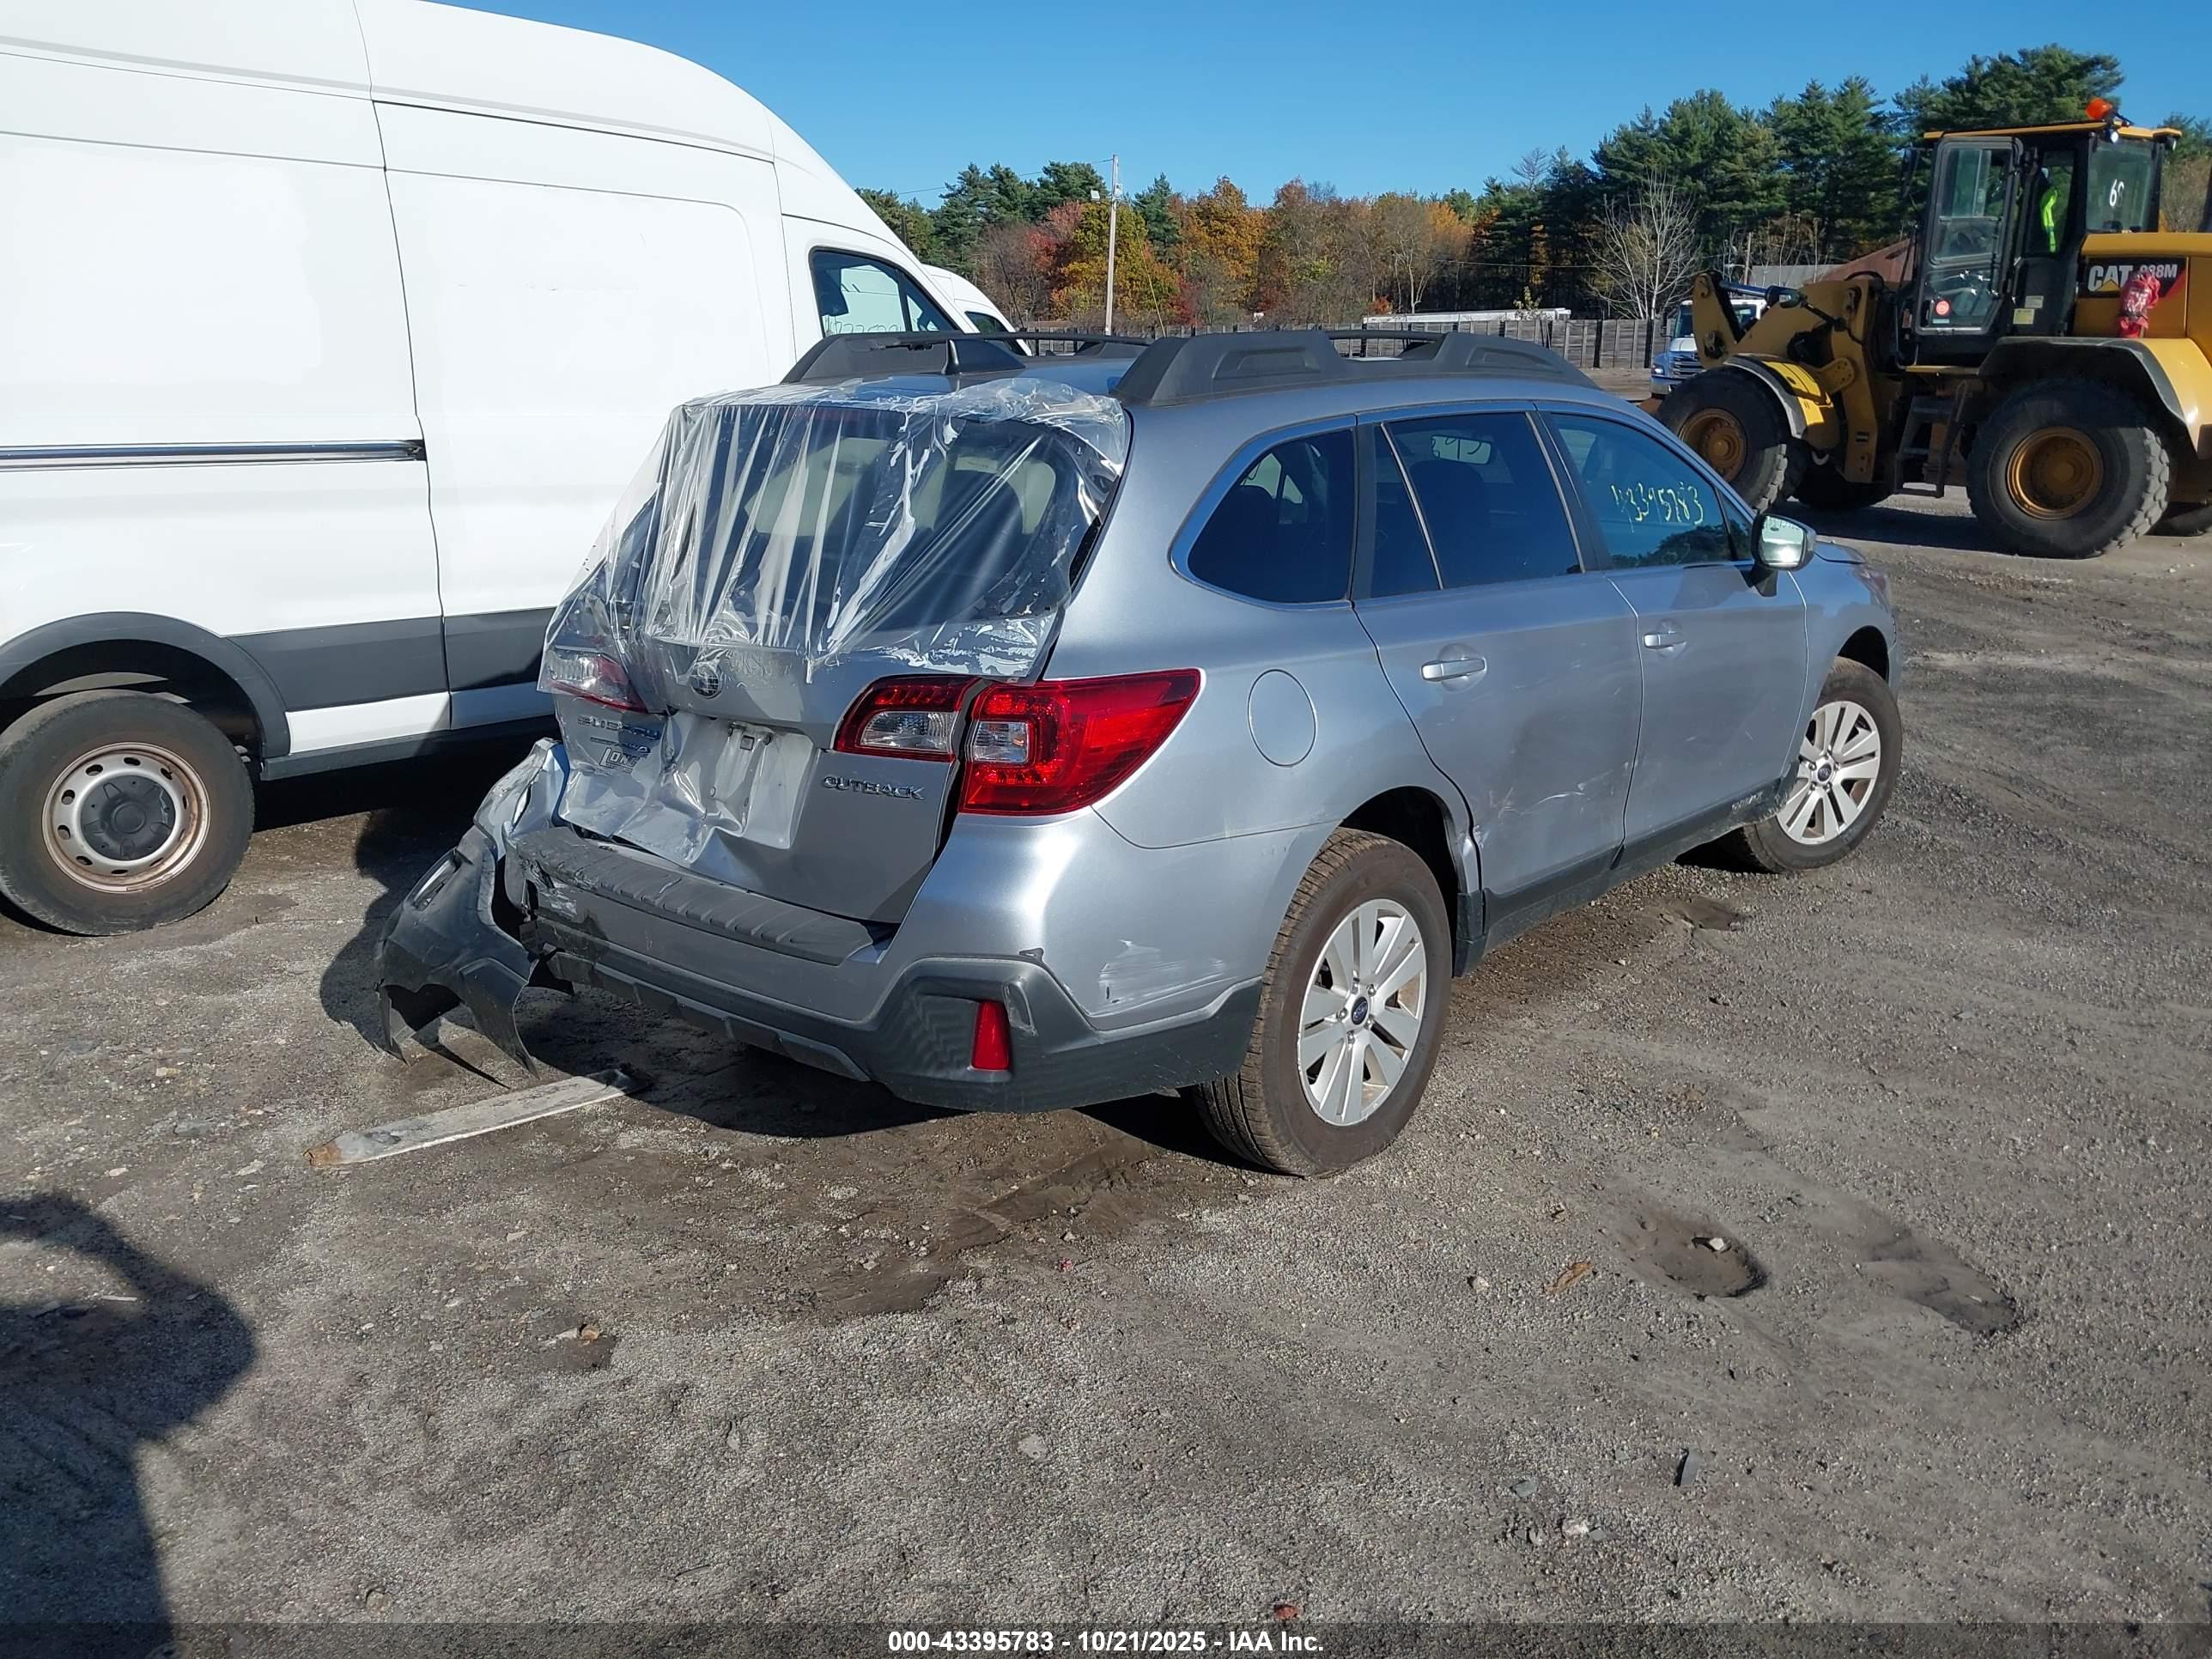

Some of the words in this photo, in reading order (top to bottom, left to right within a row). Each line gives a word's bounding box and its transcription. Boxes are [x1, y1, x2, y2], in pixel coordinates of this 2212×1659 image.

[2087, 264, 2134, 292] CAT
[1610, 481, 1704, 534] 43395783
[823, 775, 925, 799] OUTBACK
